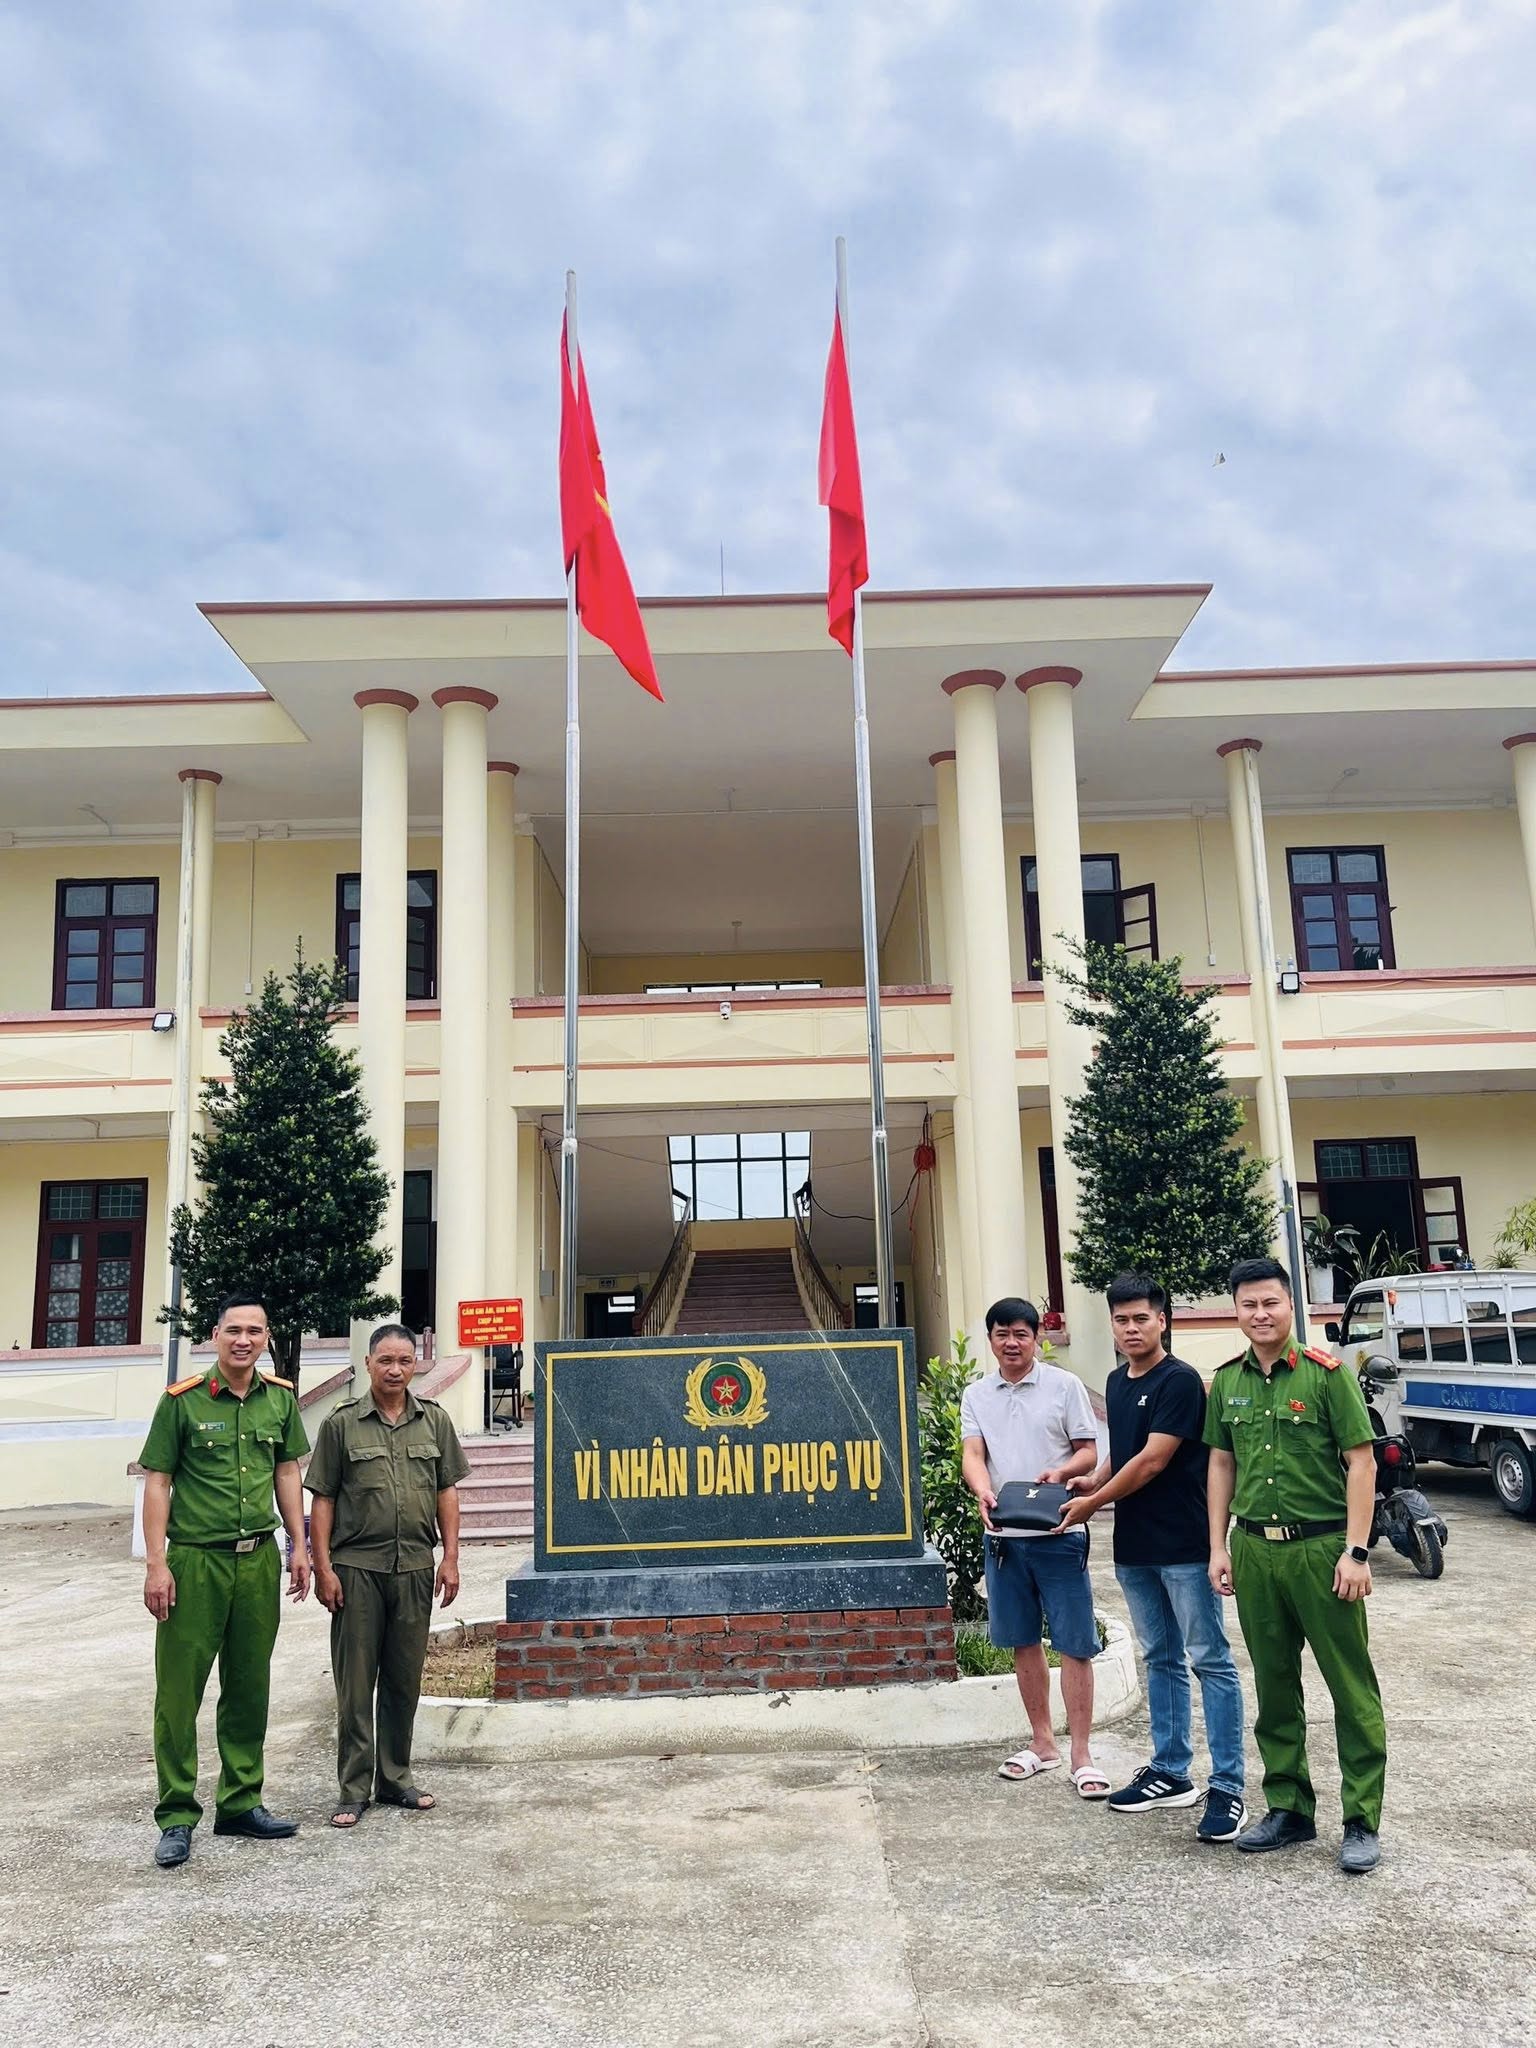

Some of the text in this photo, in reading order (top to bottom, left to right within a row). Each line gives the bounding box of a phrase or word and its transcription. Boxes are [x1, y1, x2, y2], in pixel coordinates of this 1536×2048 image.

[1440, 1385, 1518, 1412] CẢNH SÁT
[574, 1434, 882, 1504] VÌ NHÂN DÂN PHỤC VỤ
